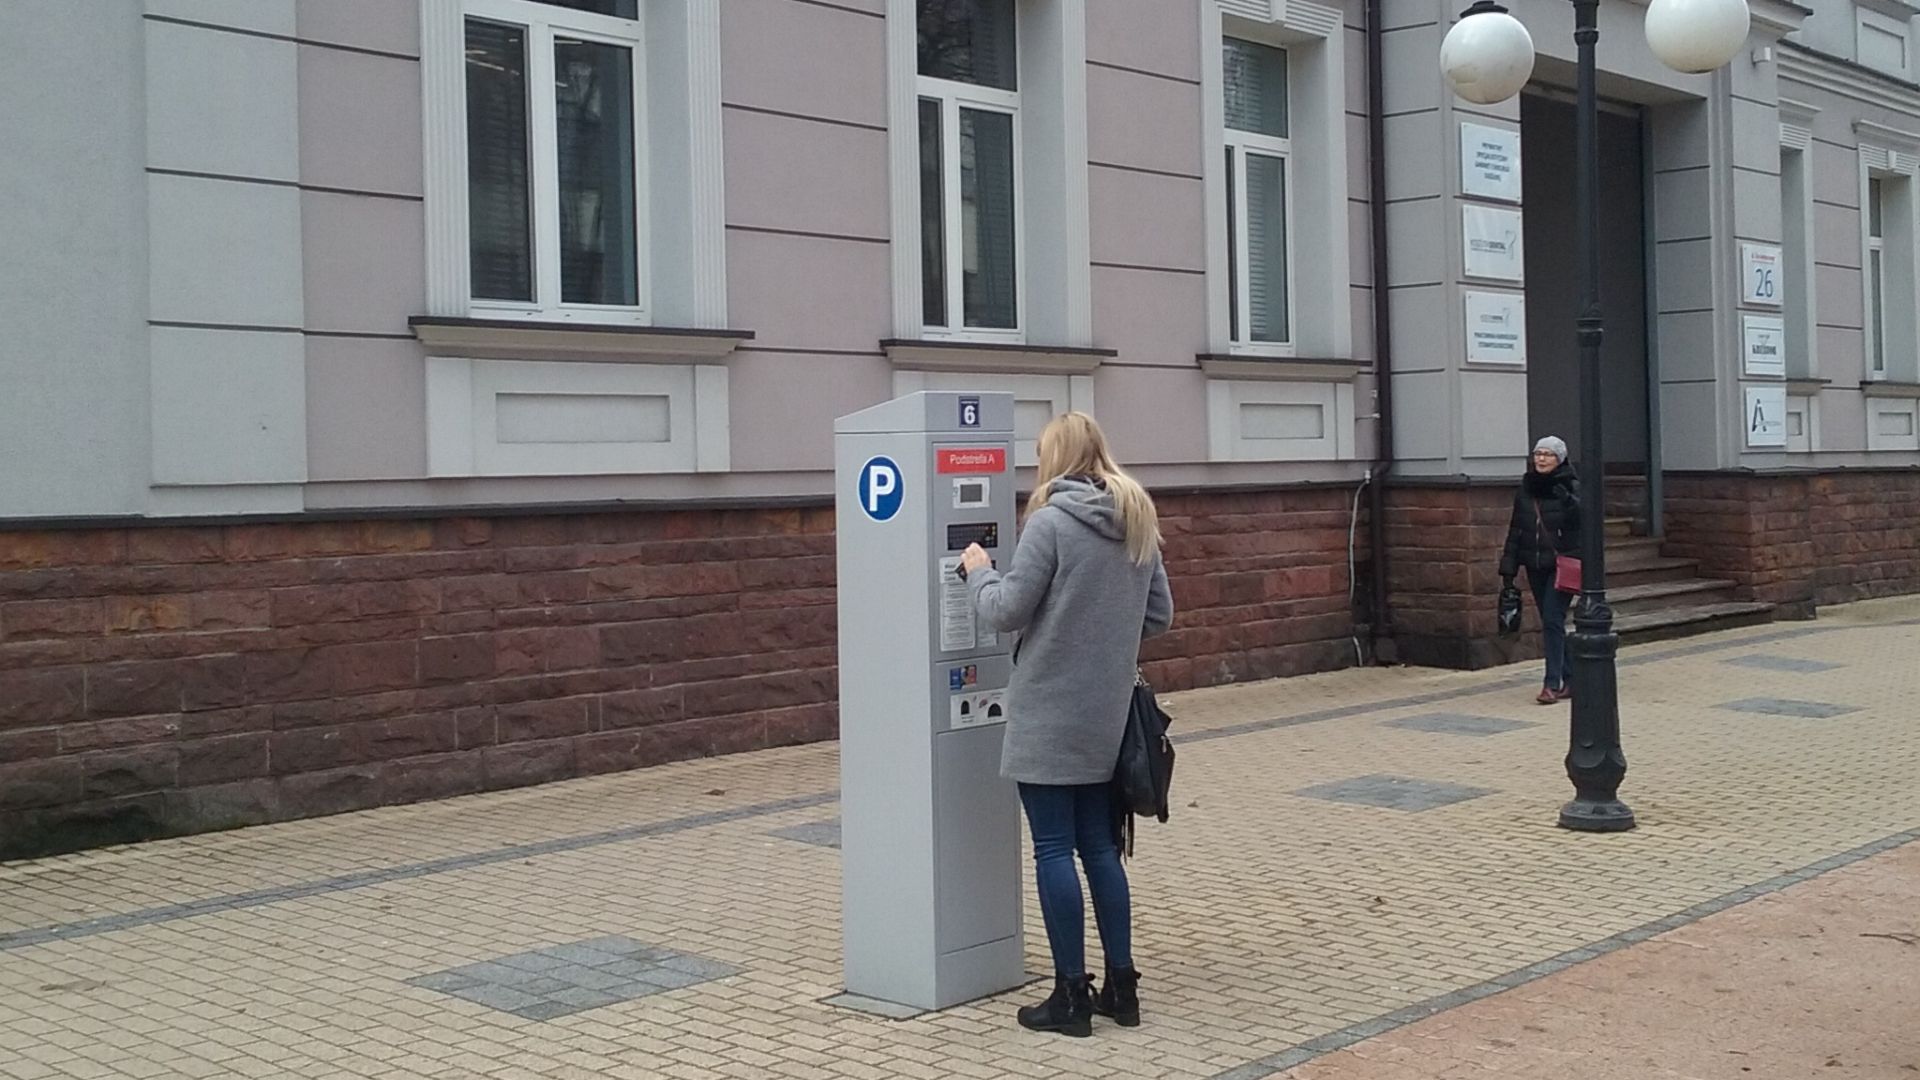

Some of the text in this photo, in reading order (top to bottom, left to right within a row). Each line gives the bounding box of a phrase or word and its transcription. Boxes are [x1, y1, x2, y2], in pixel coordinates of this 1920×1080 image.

[1755, 268, 1774, 298] 26
[964, 405, 976, 425] 6
[988, 453, 996, 464] A
[869, 465, 896, 512] P
